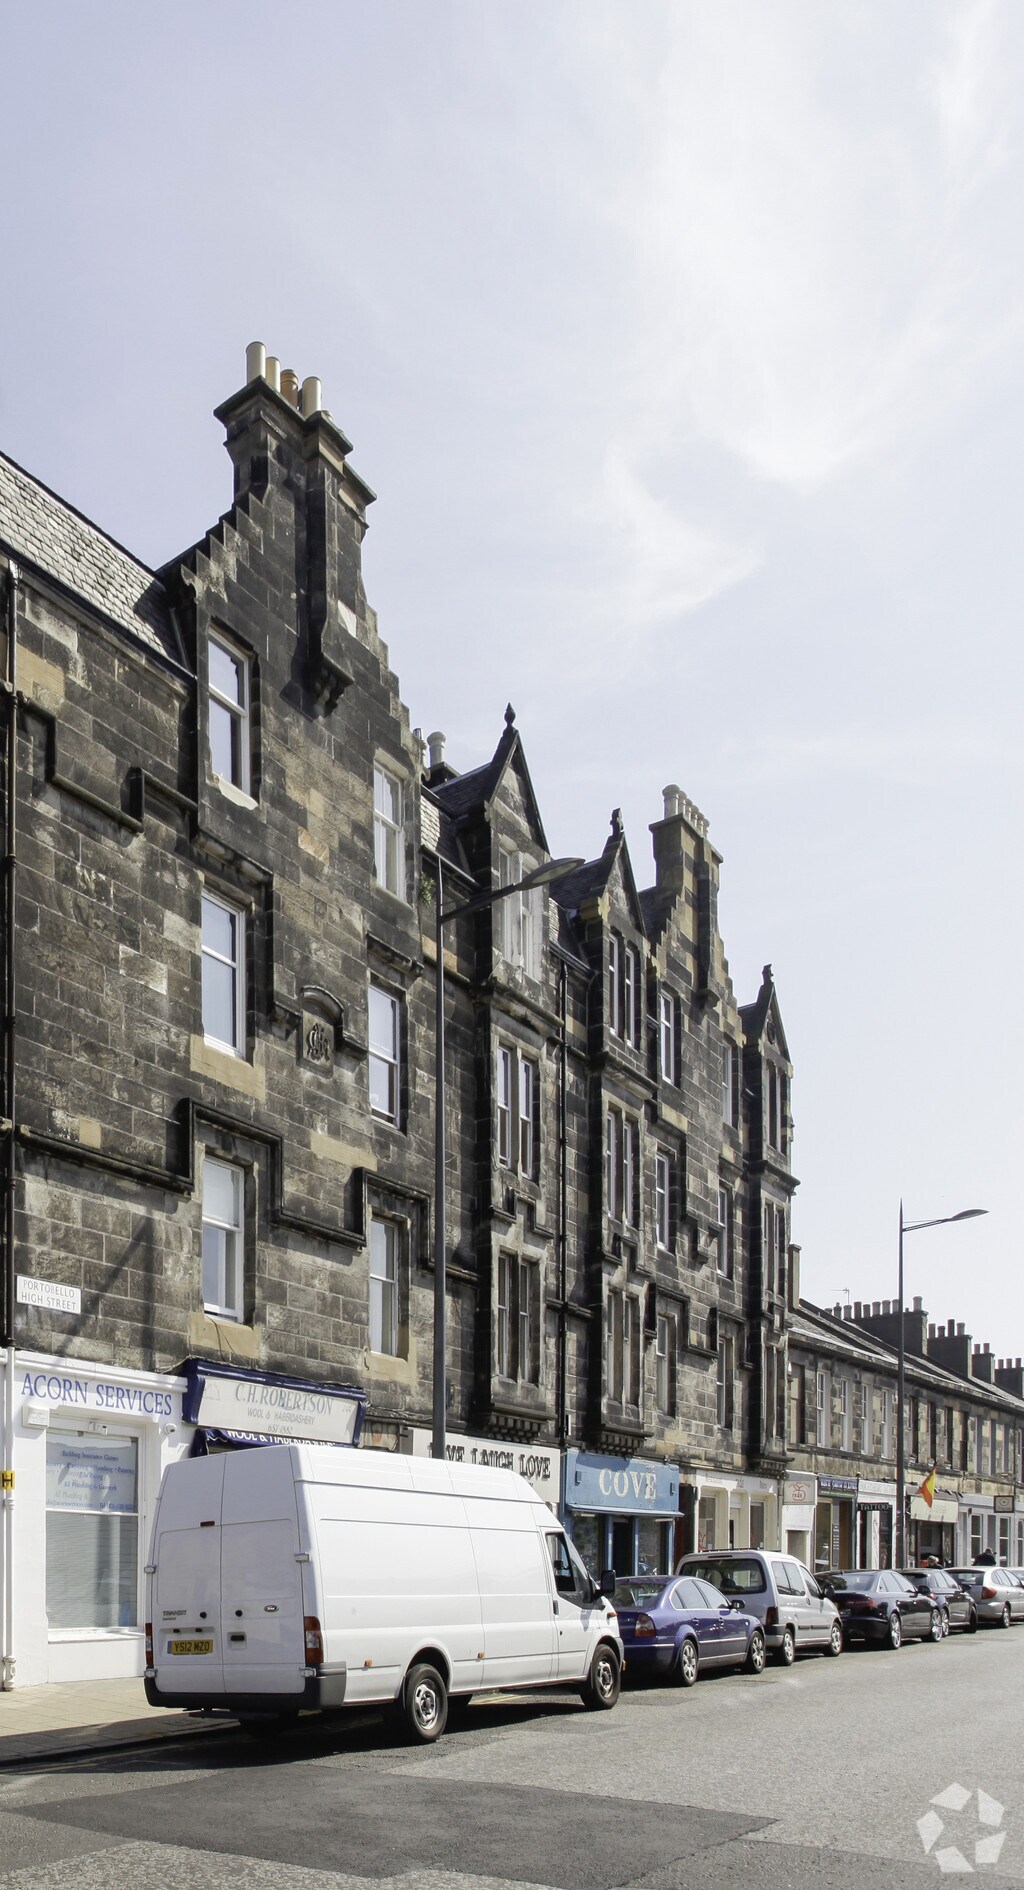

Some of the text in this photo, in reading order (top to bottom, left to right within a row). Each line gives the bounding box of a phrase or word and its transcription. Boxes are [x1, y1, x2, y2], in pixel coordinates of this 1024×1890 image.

[23, 1280, 75, 1299] PORTOBELLO
[21, 1292, 77, 1311] HIGH STREET
[21, 1372, 172, 1416] ACORN SERVICES
[247, 1407, 265, 1420] WOOL
[518, 1453, 551, 1480] LOVE
[1, 1472, 13, 1488] H
[598, 1467, 657, 1500] COVE
[859, 1503, 890, 1511] TATTOO
